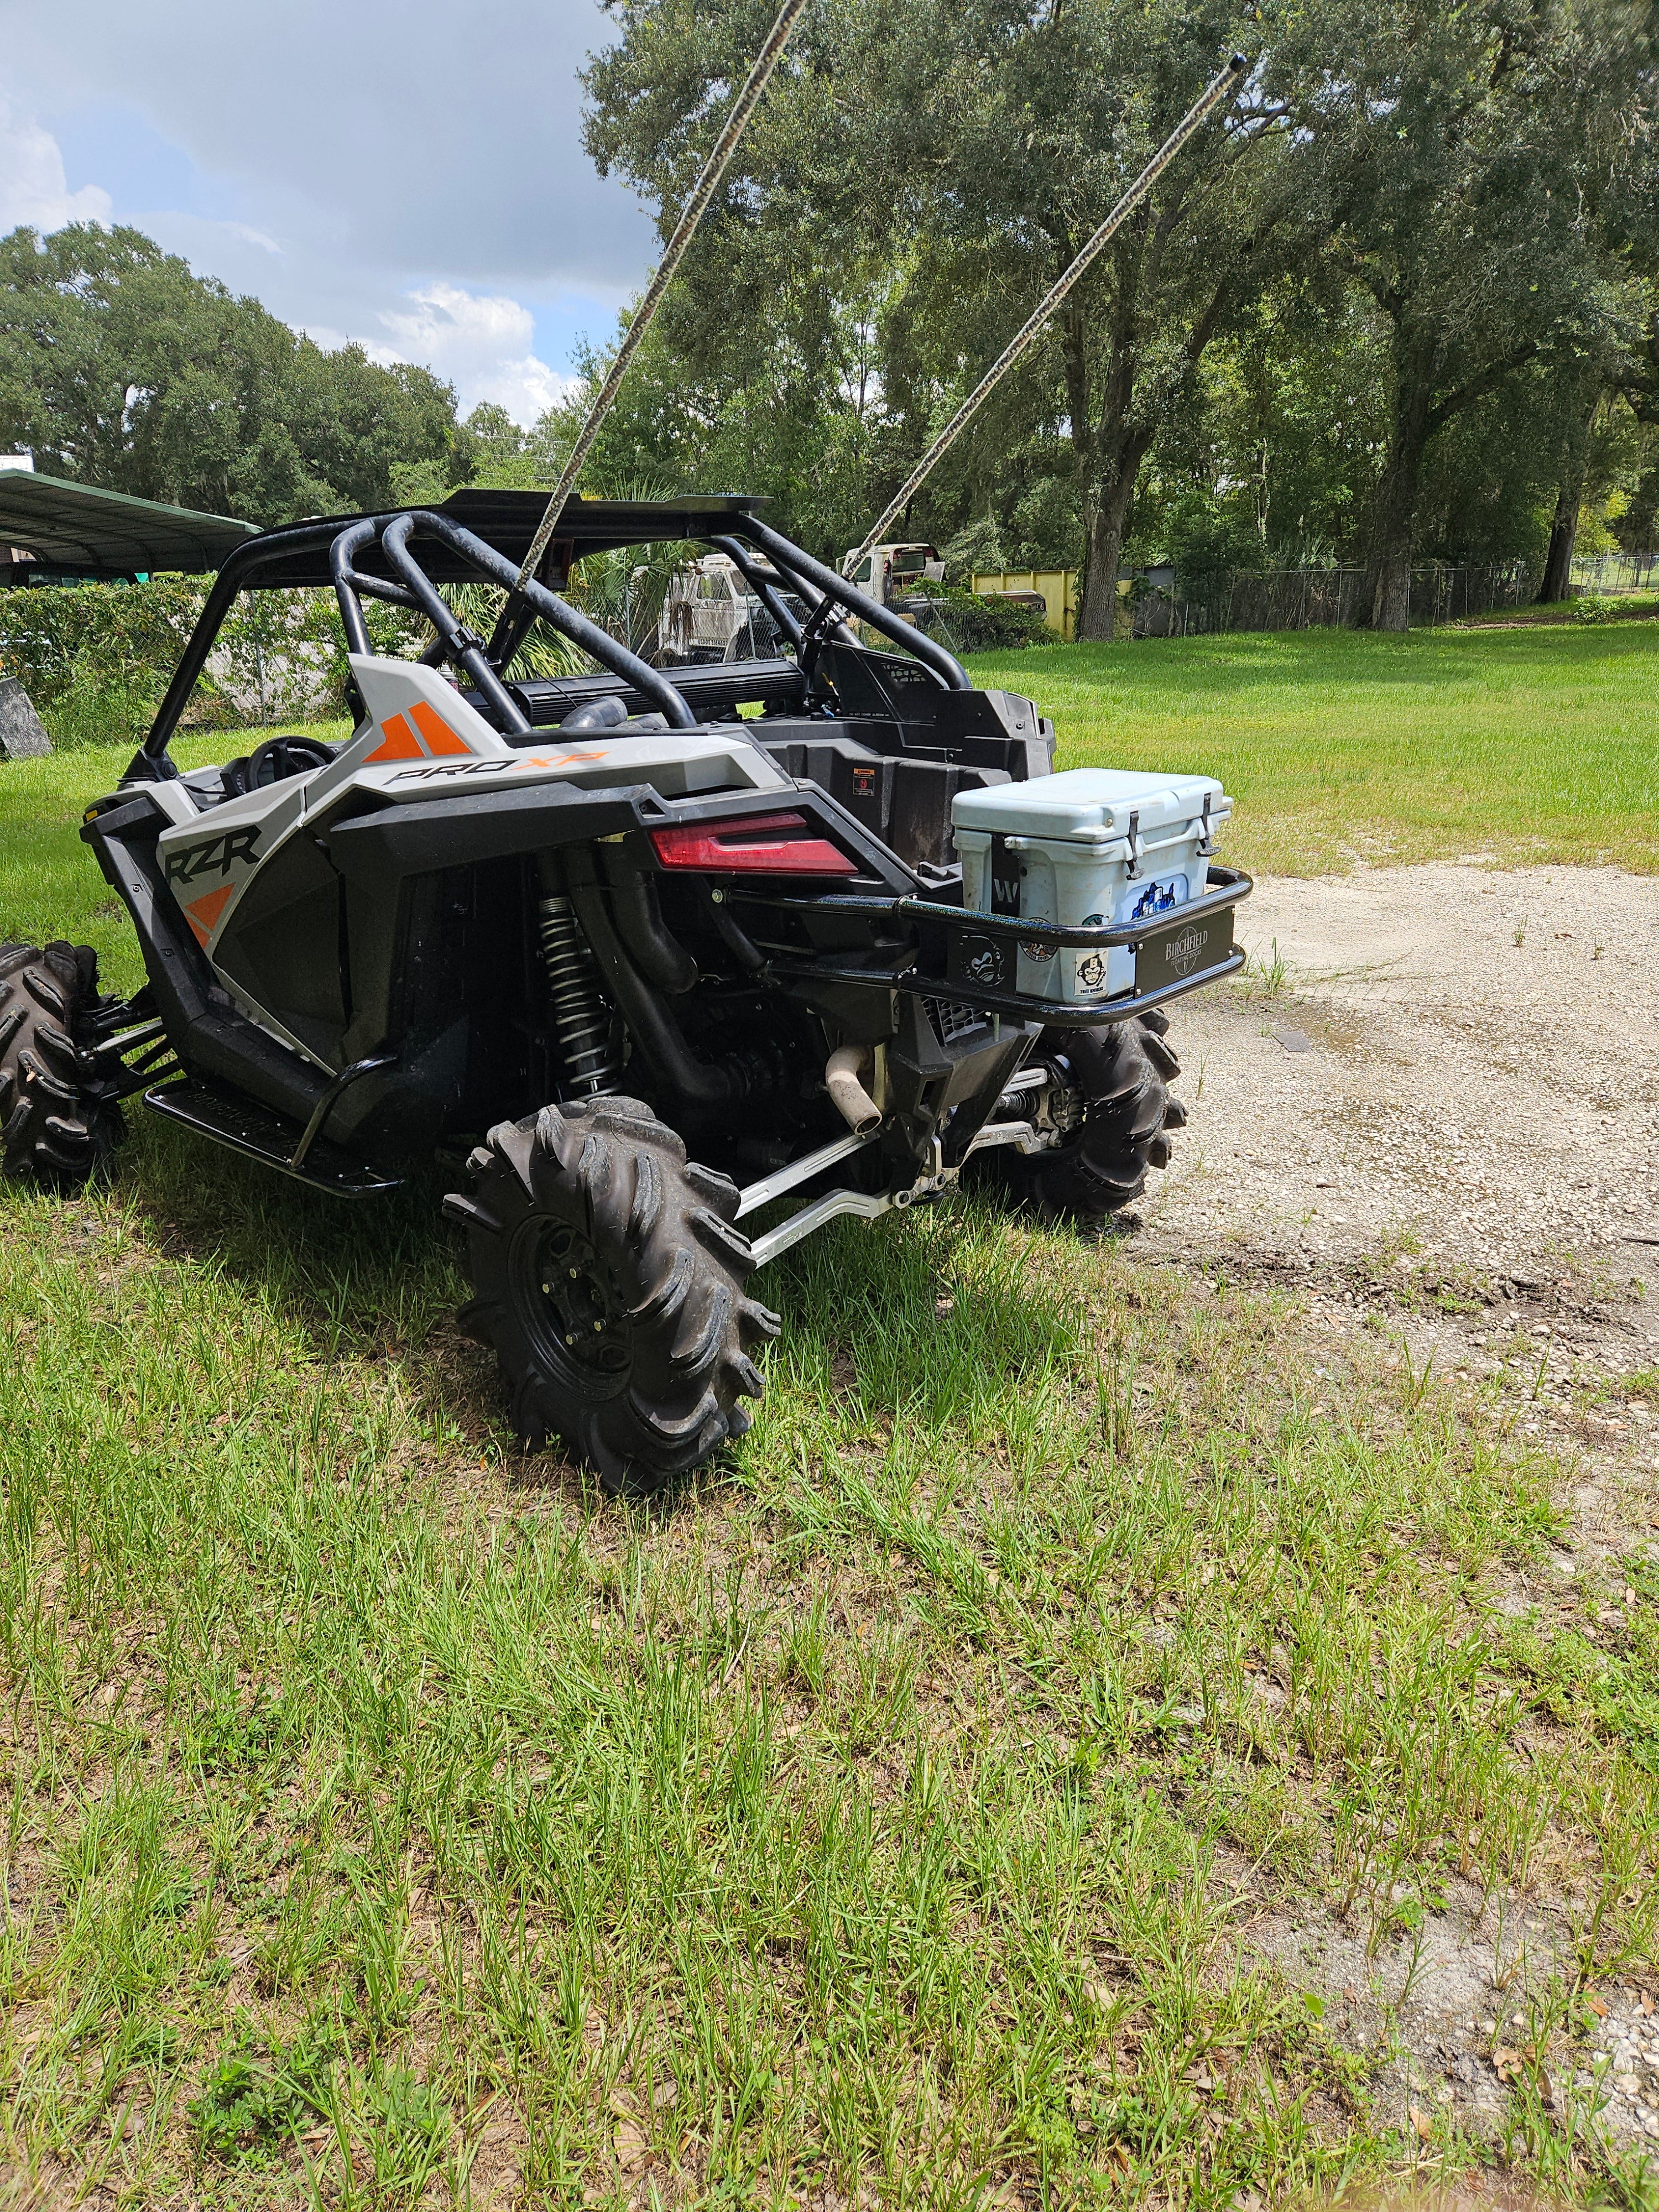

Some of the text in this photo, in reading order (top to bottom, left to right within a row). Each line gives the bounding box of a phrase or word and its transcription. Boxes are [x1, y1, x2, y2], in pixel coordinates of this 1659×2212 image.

[382, 752, 609, 786] PRO XP
[165, 825, 262, 887] RZR
[1165, 930, 1208, 961] BIRCHFIELD
[1171, 949, 1202, 967] FLOATING DOCKS
[1089, 958, 1098, 968] B
